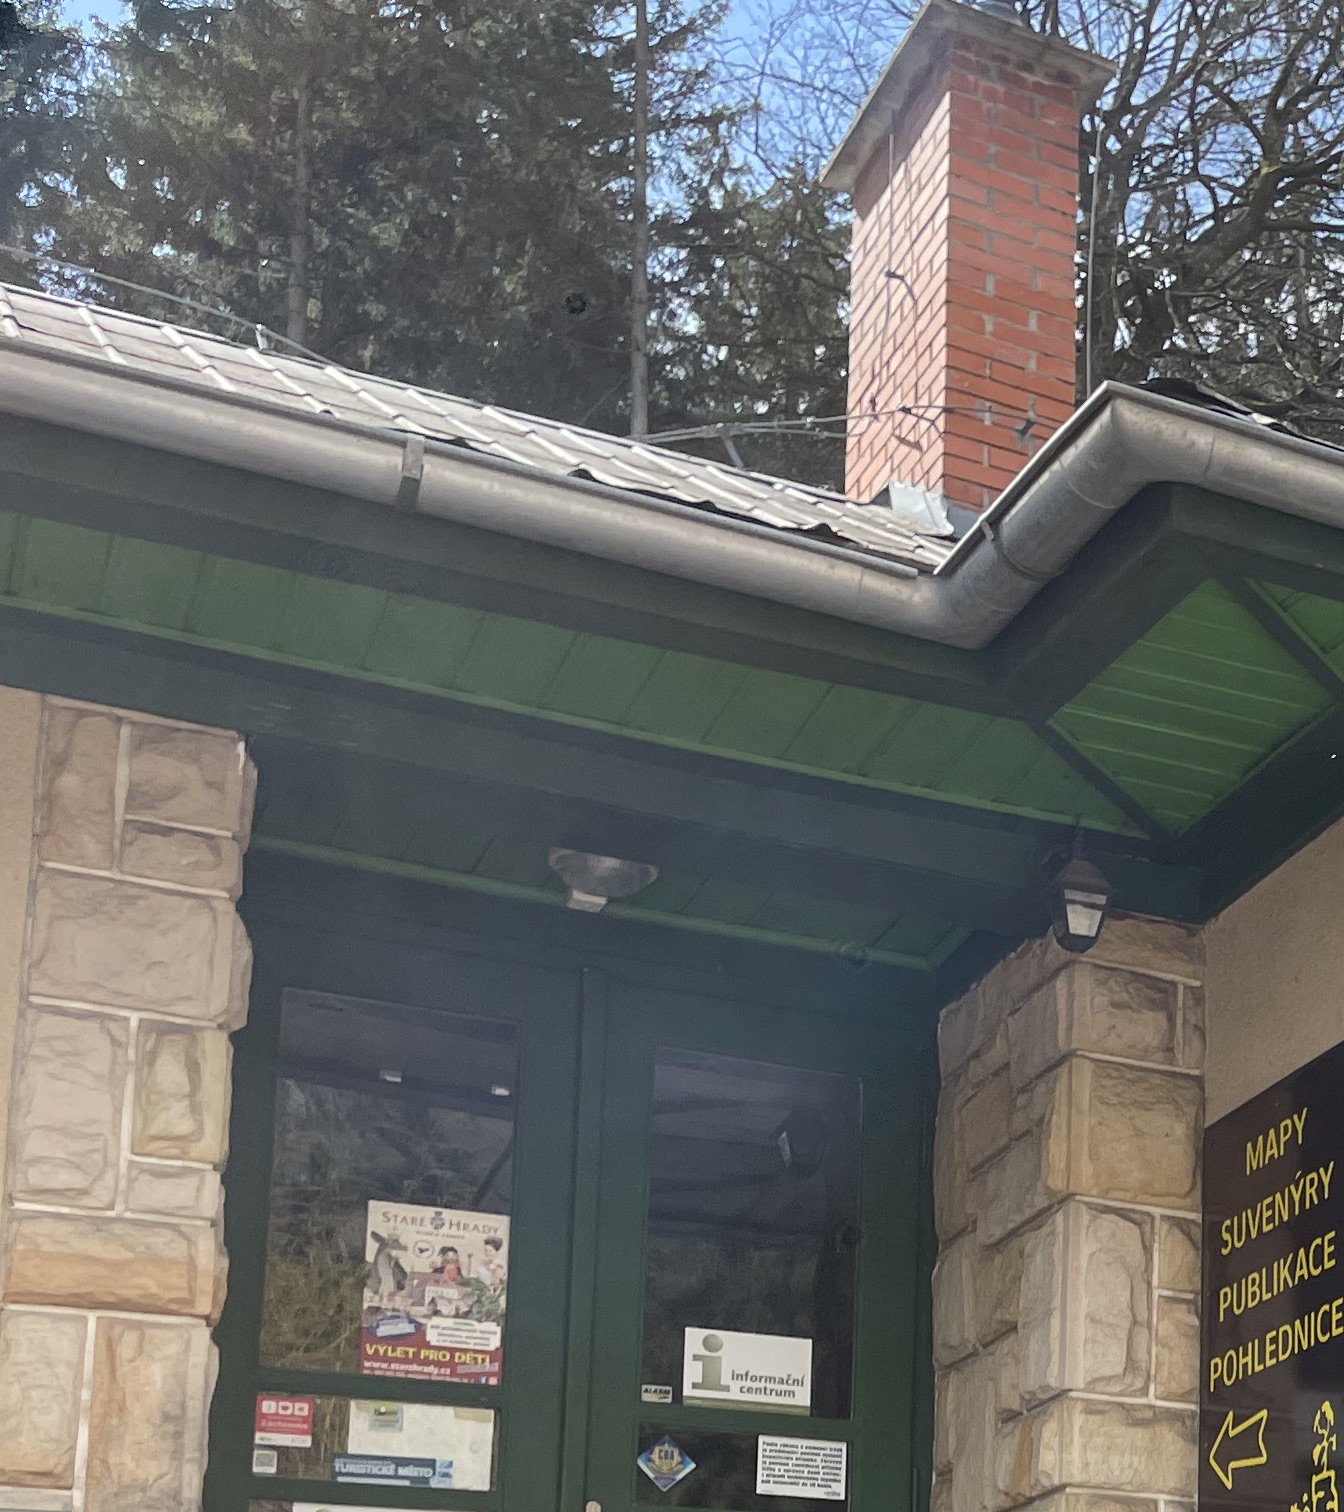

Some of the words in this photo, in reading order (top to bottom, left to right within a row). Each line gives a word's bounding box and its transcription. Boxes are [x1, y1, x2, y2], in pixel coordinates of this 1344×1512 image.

[1246, 1107, 1308, 1176] MAPY
[1221, 1161, 1335, 1256] SUVENÝRY
[1219, 1230, 1336, 1322] PUBLIKACE
[419, 1349, 450, 1362] PRO
[731, 1368, 805, 1388] informační
[1209, 1297, 1344, 1393] POHLEDNICE
[739, 1383, 796, 1399] centrum
